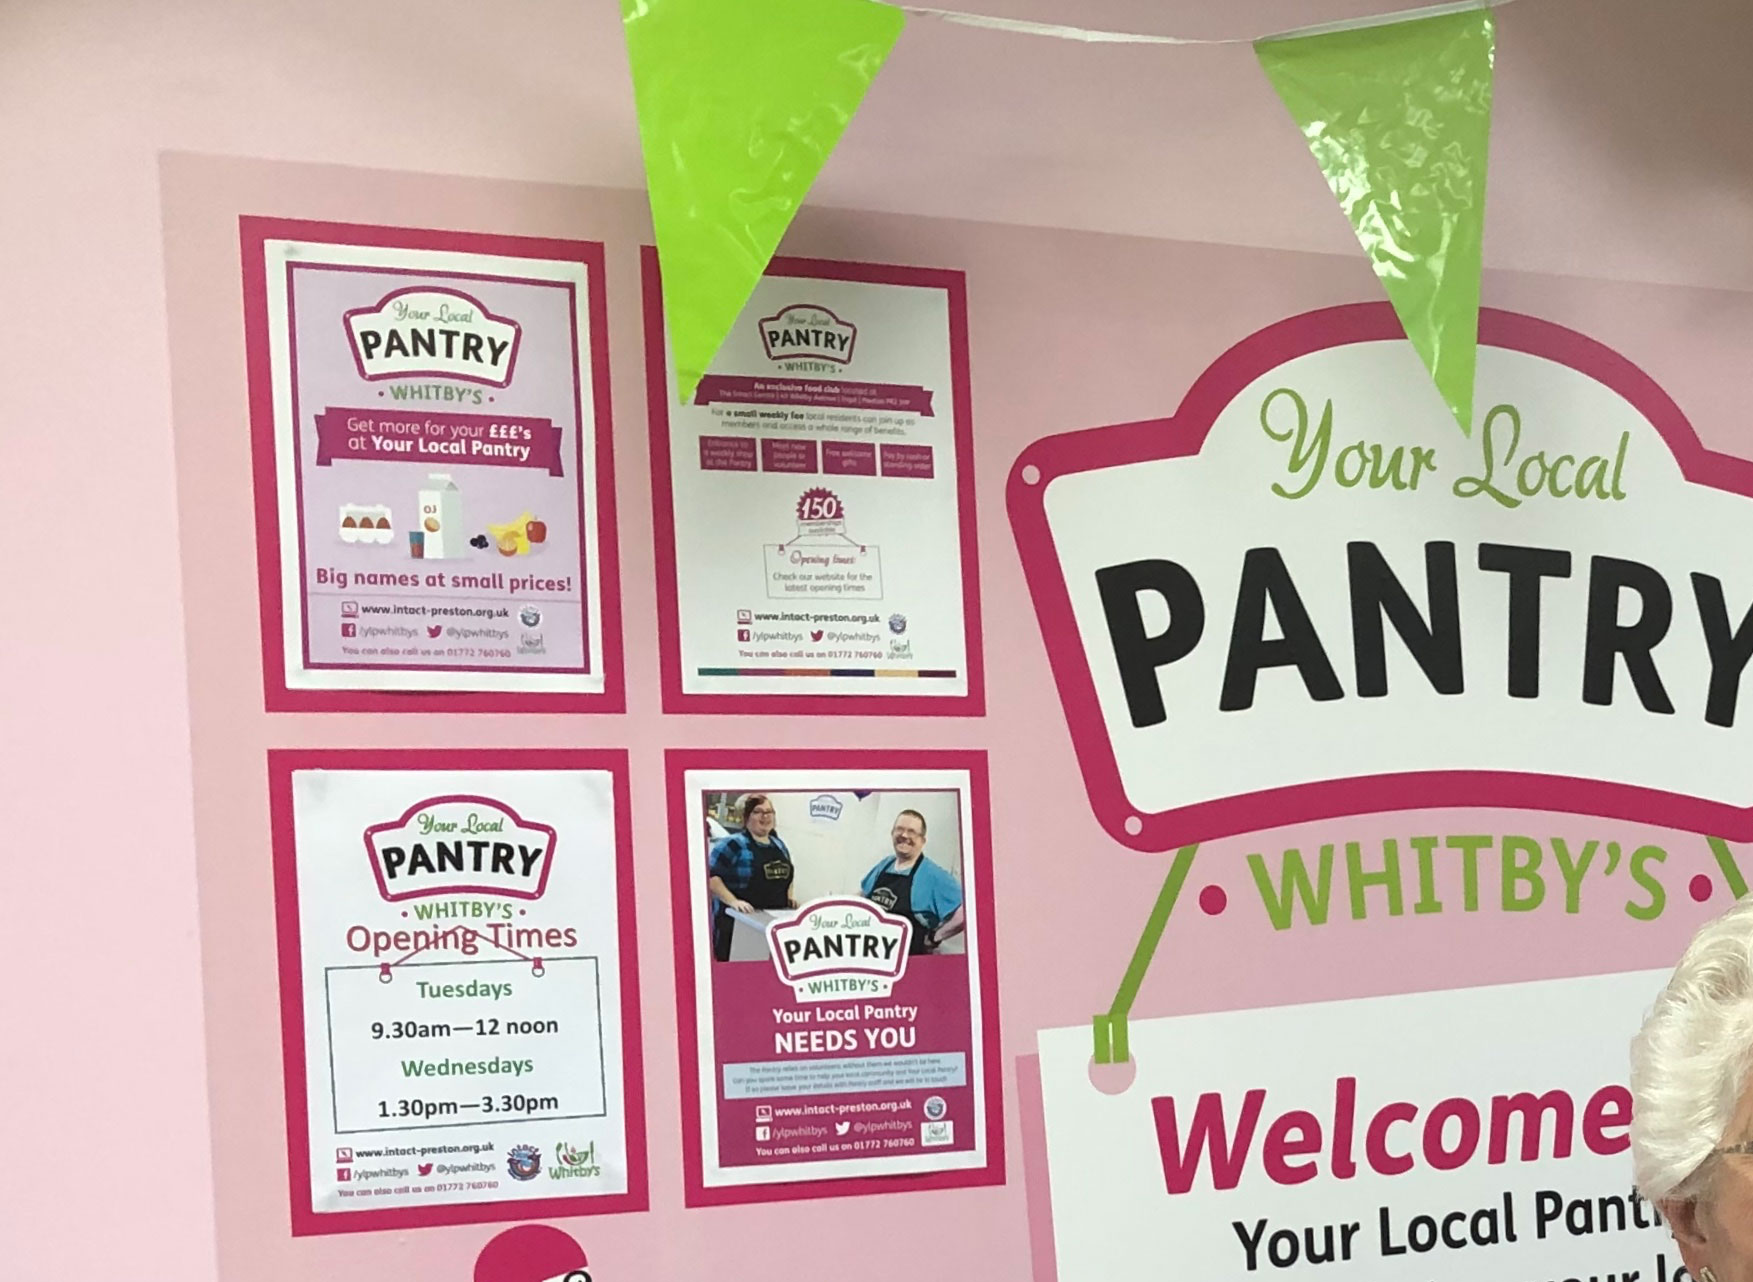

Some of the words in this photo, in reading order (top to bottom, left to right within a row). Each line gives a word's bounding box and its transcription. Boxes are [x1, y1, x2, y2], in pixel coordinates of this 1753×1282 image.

[392, 301, 429, 321] Your
[434, 304, 472, 323] Local
[360, 328, 509, 366] PANTRY
[768, 329, 849, 351] PANTRY
[389, 385, 482, 404] WHITBY'S
[348, 418, 375, 432] Get
[379, 421, 420, 434] more
[425, 421, 446, 435] for
[450, 426, 484, 439] your
[489, 425, 532, 439] £££'s
[349, 438, 367, 449] at
[371, 435, 412, 452] Your
[419, 438, 466, 454] Local
[472, 441, 530, 461] Pantry
[1260, 388, 1437, 499] Your
[1453, 405, 1630, 508] Local
[802, 497, 836, 518] 150
[316, 568, 348, 588] Big
[354, 574, 419, 587] names
[426, 573, 445, 588] at
[451, 574, 504, 589] small
[509, 576, 572, 593] prices!
[362, 605, 509, 618] www.intact-preston.org.uk
[755, 612, 880, 624] www.intact-preston.org.uk
[418, 814, 457, 834] Your
[461, 814, 503, 834] Local
[382, 841, 542, 879] PANTRY
[1247, 835, 1668, 930] WHITBY'S
[414, 902, 512, 920] WHITBY'S
[809, 914, 838, 929] Your
[841, 913, 870, 928] Local
[346, 924, 478, 957] Opening
[486, 922, 578, 948] Times
[784, 934, 898, 964] PANTRY
[416, 981, 512, 1000] Tuesdays
[808, 980, 879, 994] WHITBY'S
[773, 1008, 811, 1023] Your
[816, 1006, 859, 1021] Local
[865, 1006, 918, 1022] Pantry
[506, 1020, 558, 1034] noon
[775, 1029, 857, 1054] NEEDS
[865, 1027, 916, 1049] YOU
[401, 1057, 533, 1078] Wednesdays
[379, 1095, 559, 1119] 1.30pm—3.30pm
[775, 1100, 911, 1116] www.intact-preston.org.uk
[1151, 1076, 1634, 1195] Welcome
[356, 1142, 494, 1158] www.intact-preston.org.uk
[1232, 1219, 1359, 1271] Your
[1379, 1192, 1516, 1258] Local
